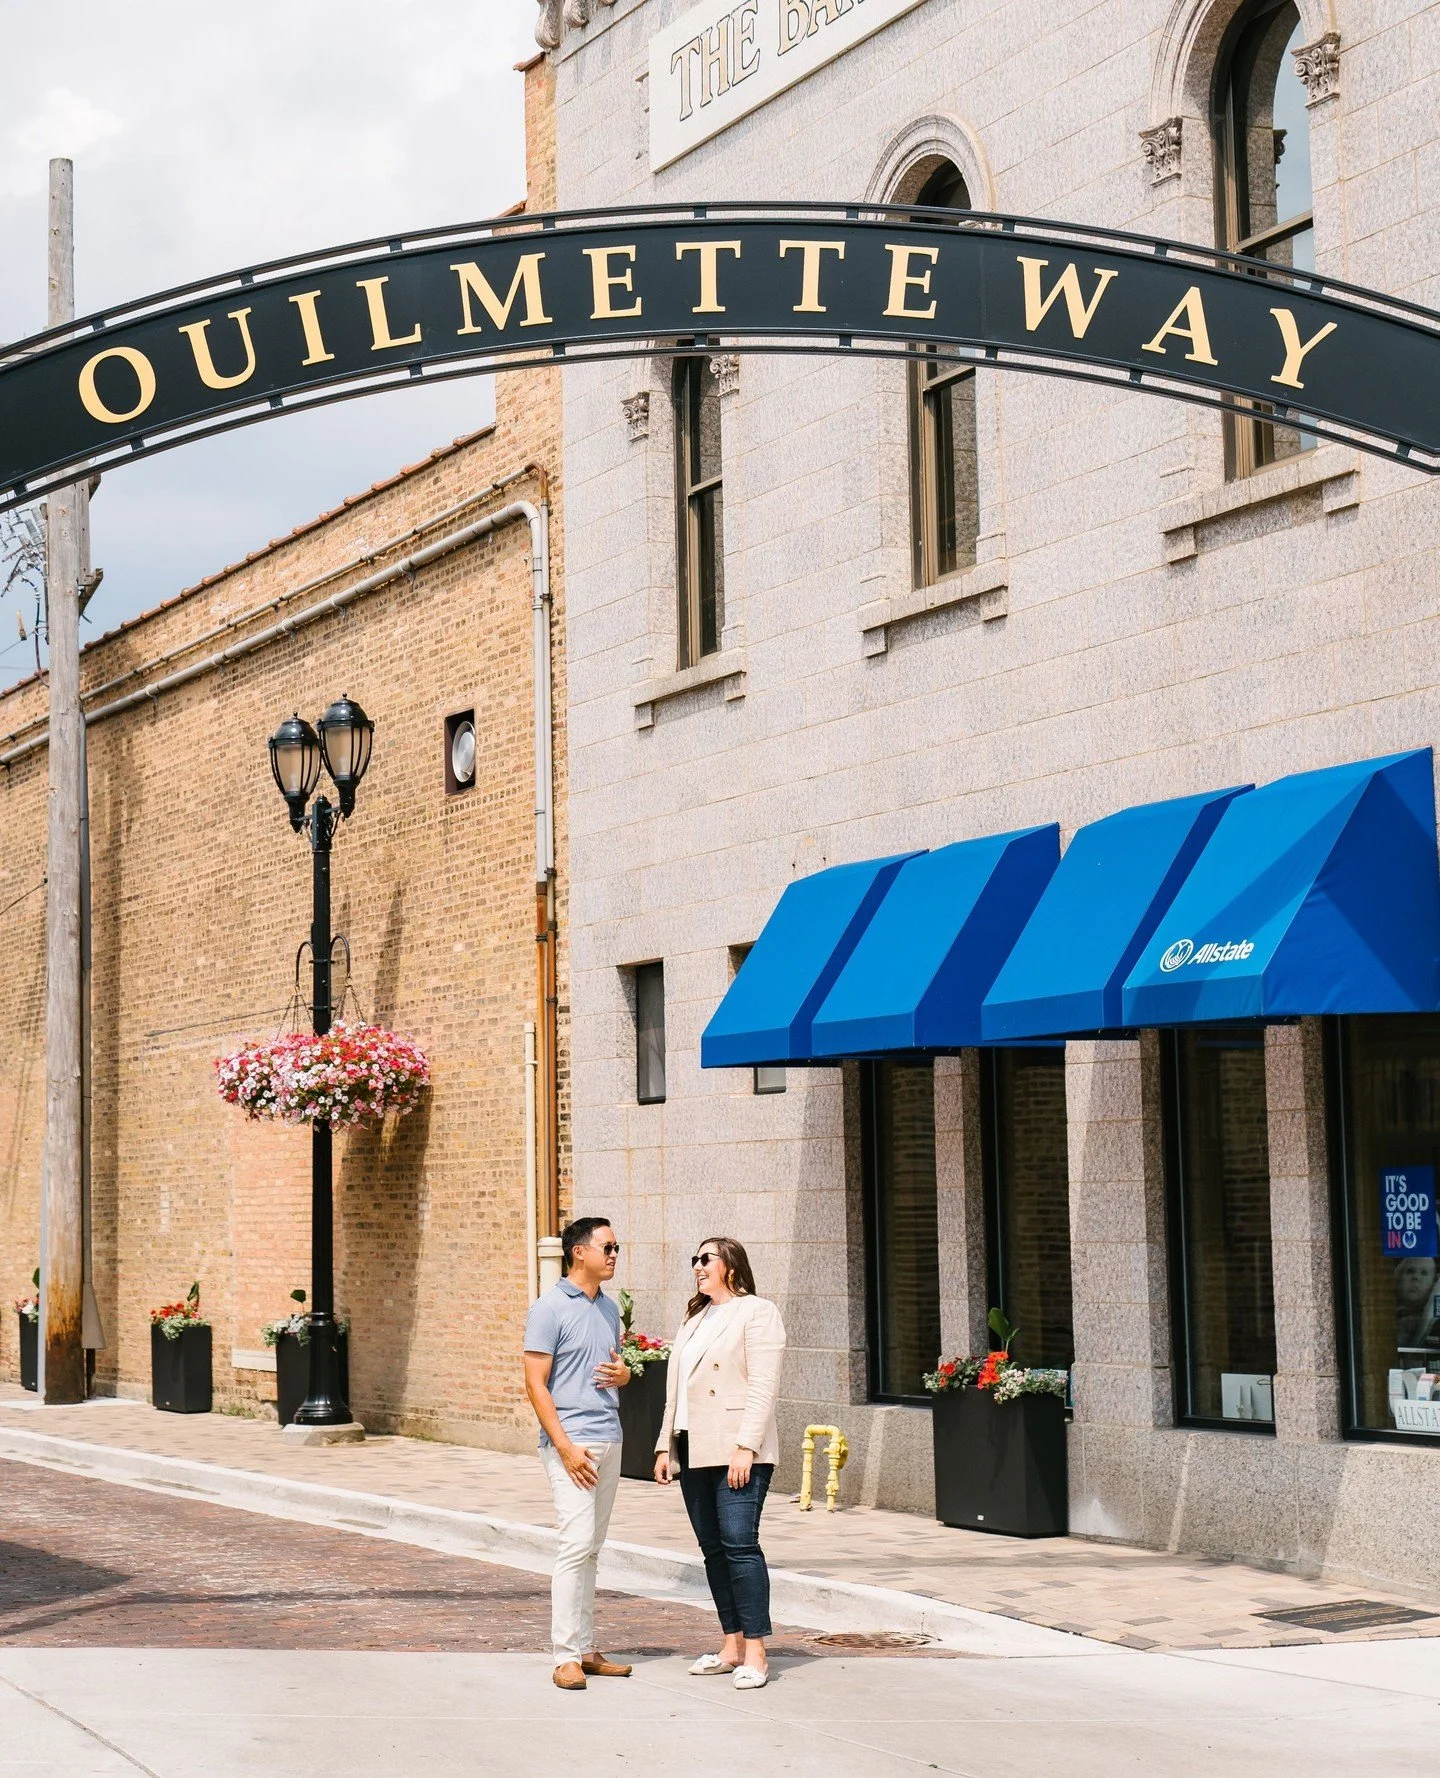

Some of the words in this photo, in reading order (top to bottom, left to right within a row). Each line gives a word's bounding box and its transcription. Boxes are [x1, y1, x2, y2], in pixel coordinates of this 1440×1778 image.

[670, 0, 760, 122] THE
[78, 240, 939, 424] OUILMETTE
[1016, 256, 1338, 389] WAY
[1187, 939, 1255, 965] Allstate
[1385, 1175, 1407, 1193] IT'S
[1385, 1193, 1429, 1212] GOOD
[1386, 1212, 1404, 1230] TO
[1406, 1212, 1422, 1230] BE
[1387, 1231, 1402, 1249] IN
[1397, 1406, 1440, 1427] ALLSTA
